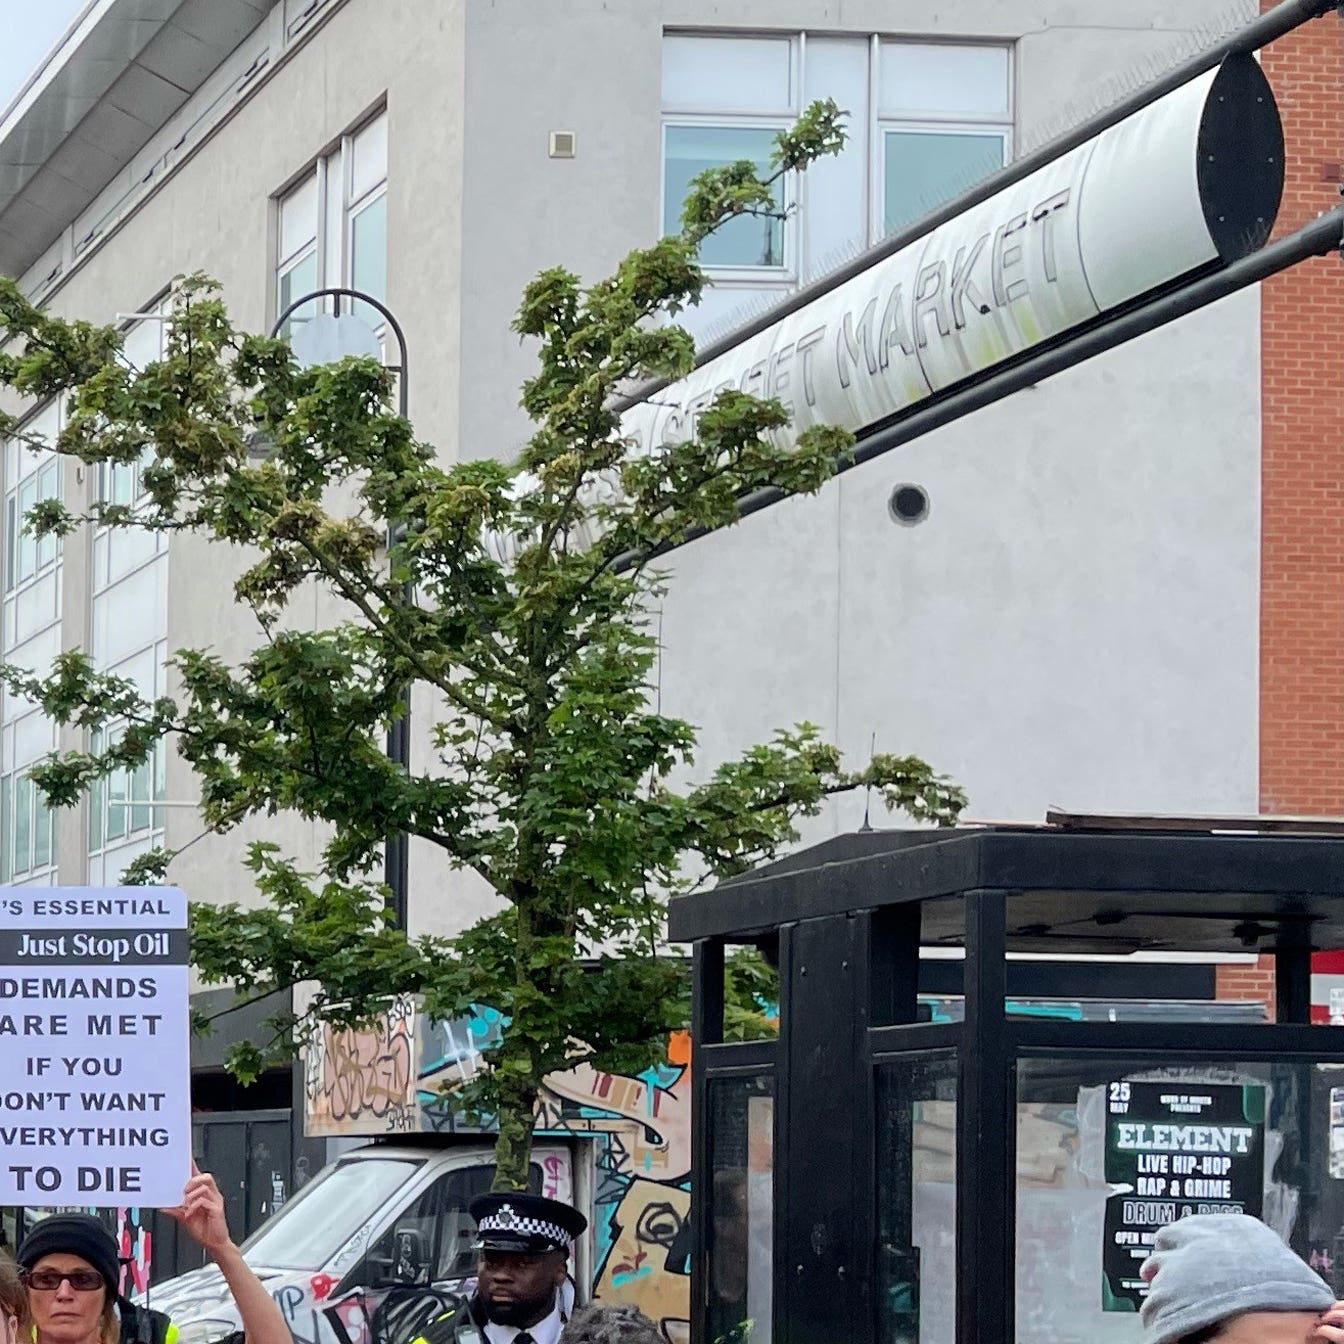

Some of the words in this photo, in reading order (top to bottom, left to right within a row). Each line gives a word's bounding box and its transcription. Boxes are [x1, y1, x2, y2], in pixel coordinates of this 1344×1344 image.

[837, 188, 1071, 389] MARKET
[33, 899, 170, 916] ESSENTIAL
[17, 934, 67, 957] Just
[72, 933, 130, 962] Stop
[134, 932, 170, 956] Oil
[0, 977, 157, 999] DEMANDS
[87, 1015, 162, 1035] MET
[27, 1057, 52, 1076] IF
[62, 1057, 123, 1076] YOU
[80, 1092, 166, 1111] WANT
[1109, 1082, 1131, 1101] 25
[1109, 1102, 1129, 1114] MAY
[1117, 1123, 1252, 1153] ELEMENT
[1137, 1154, 1169, 1174] LIVE
[1172, 1155, 1231, 1176] HIP-HOP
[9, 1166, 62, 1192] TO
[77, 1166, 142, 1192] DIE
[1137, 1177, 1166, 1197] RAP
[1169, 1179, 1180, 1197] &
[1184, 1179, 1231, 1199] GRIME
[1123, 1201, 1176, 1226] DRUM
[1115, 1231, 1139, 1245] OPEN
